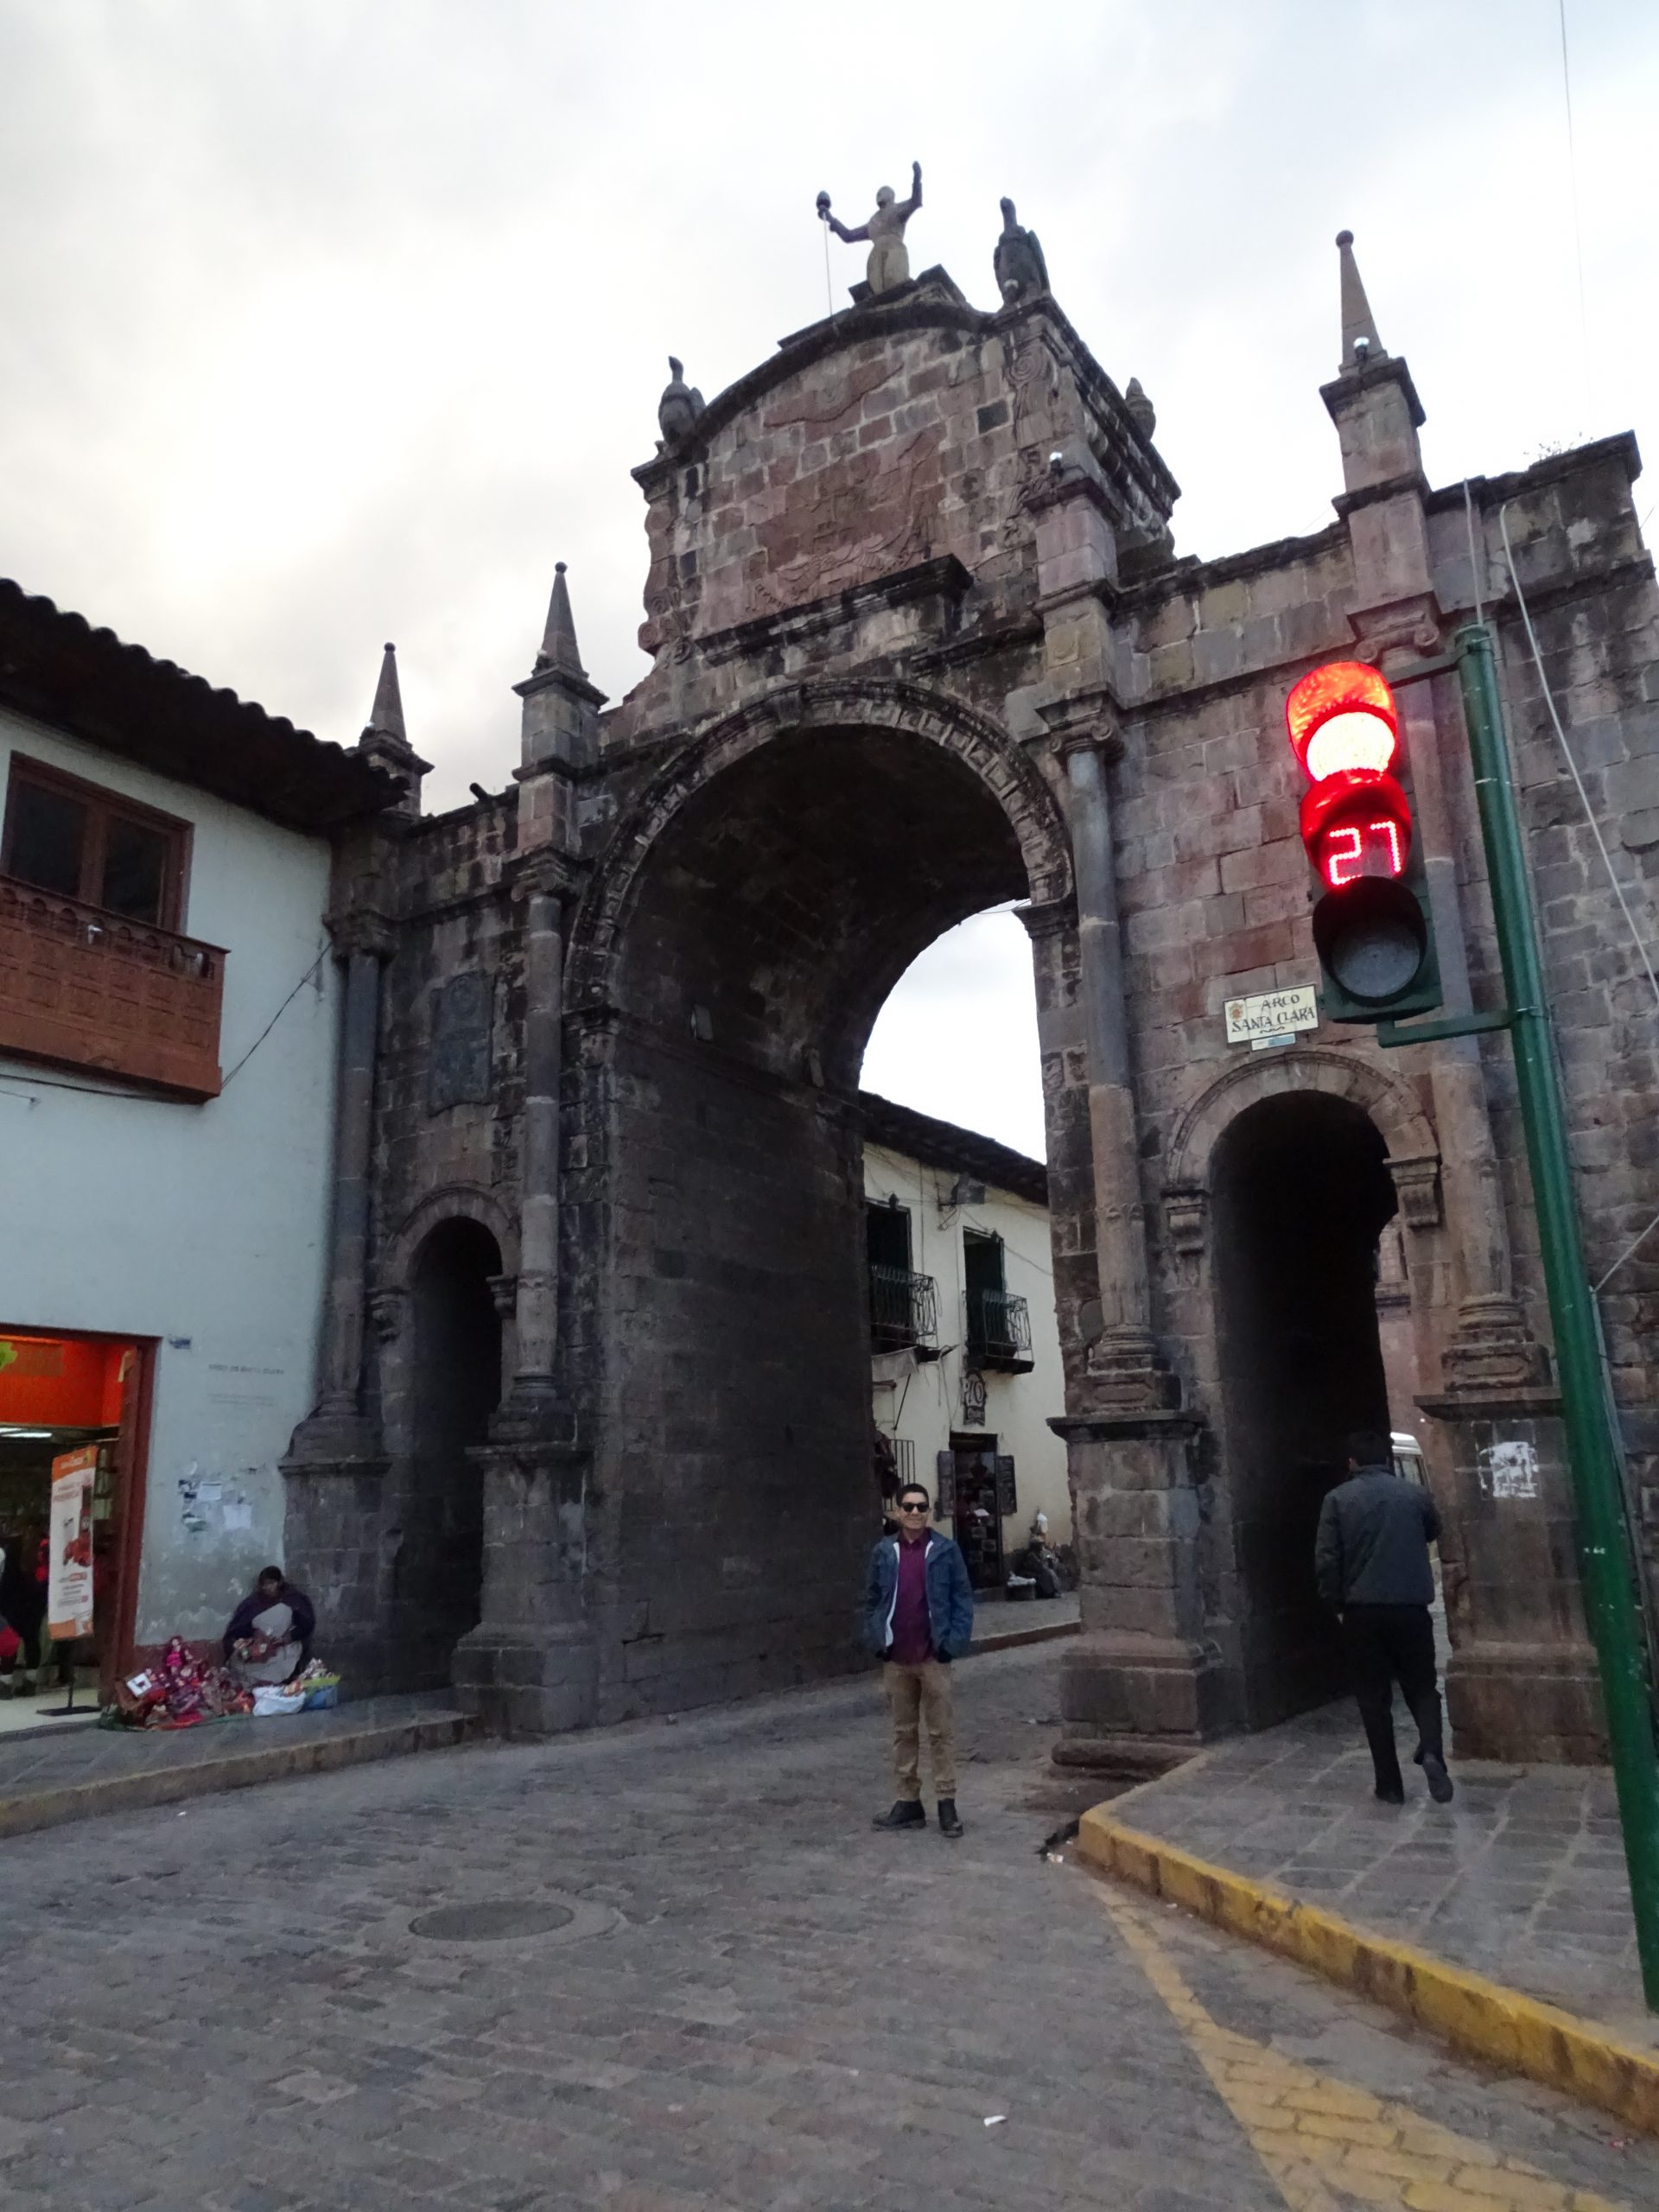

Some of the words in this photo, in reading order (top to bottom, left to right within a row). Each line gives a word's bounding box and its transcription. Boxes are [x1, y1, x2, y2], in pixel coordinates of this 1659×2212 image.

[1329, 821, 1402, 885] 27
[1262, 995, 1300, 1010] ARCO
[1231, 1016, 1273, 1033] SANTA
[1277, 1007, 1315, 1025] CLARA
